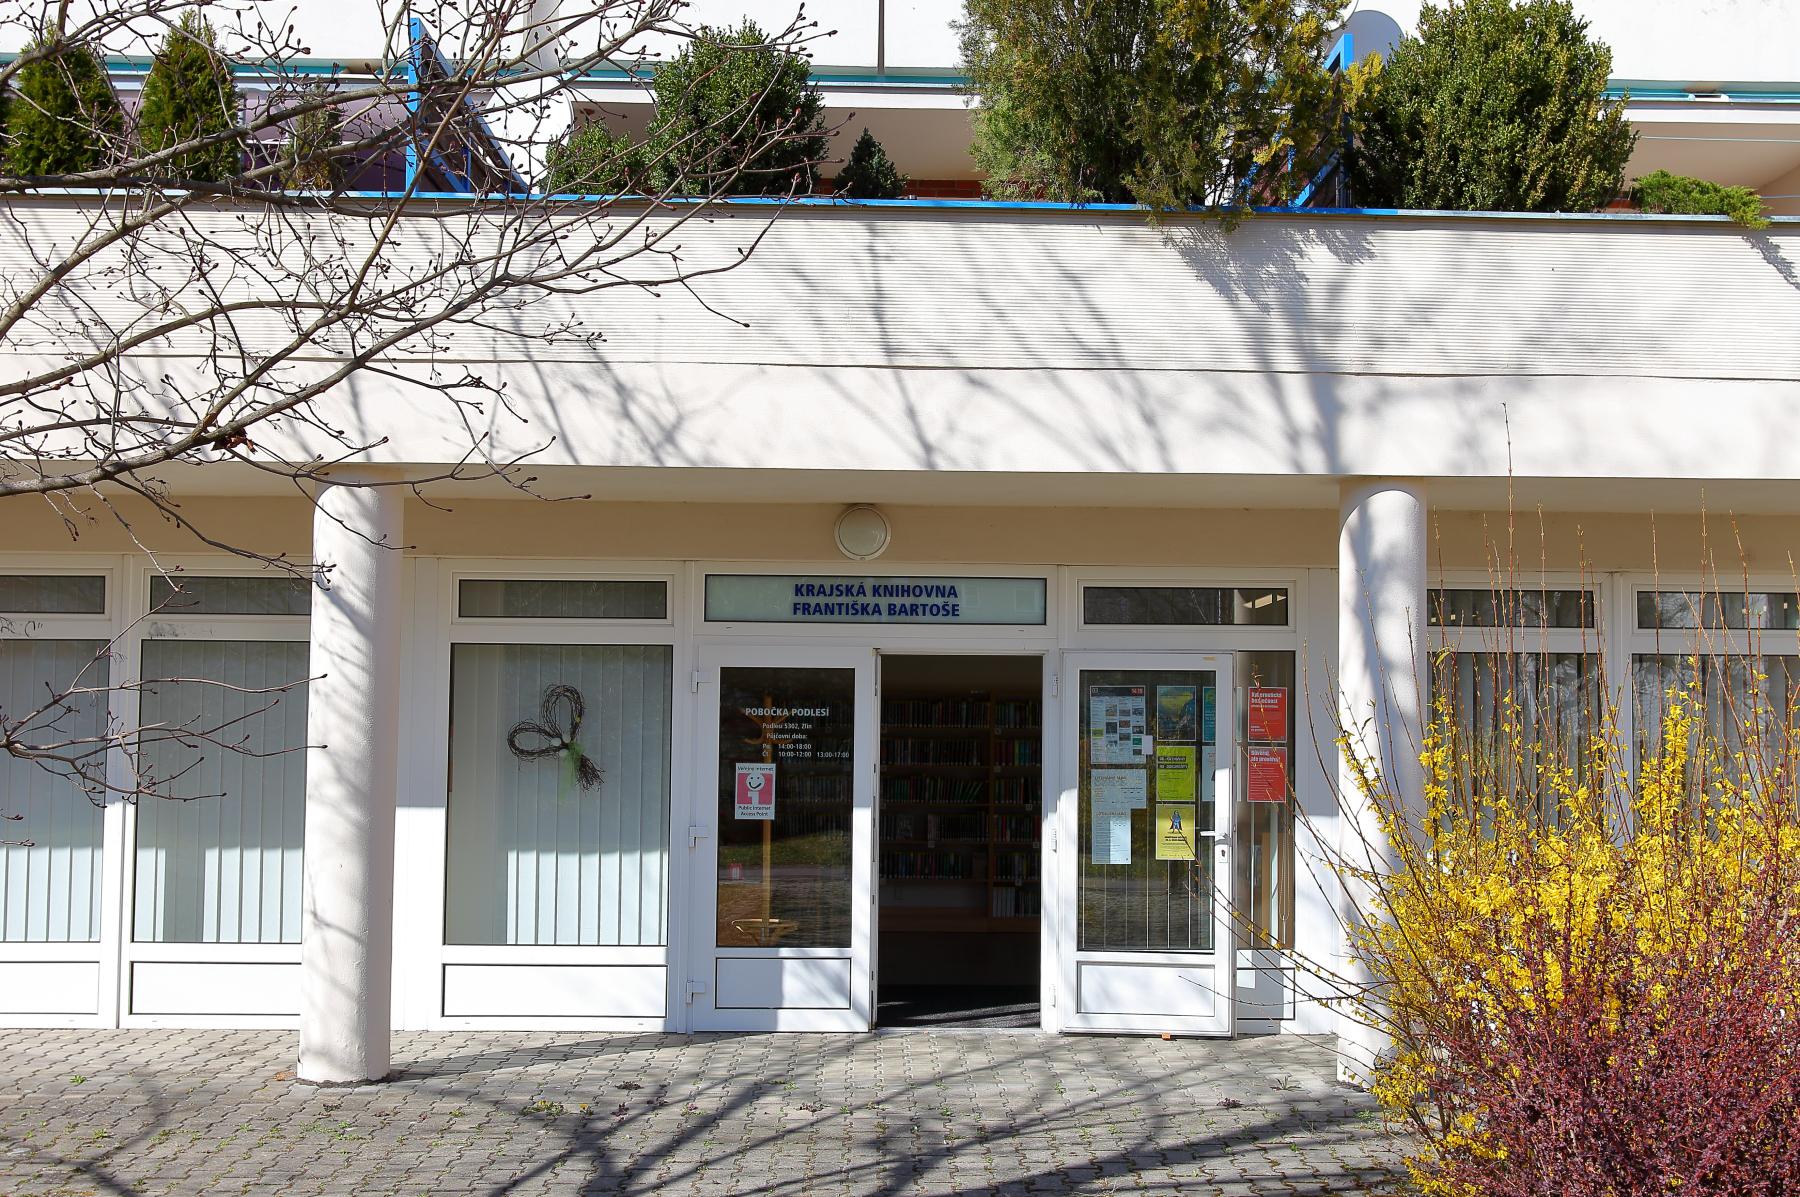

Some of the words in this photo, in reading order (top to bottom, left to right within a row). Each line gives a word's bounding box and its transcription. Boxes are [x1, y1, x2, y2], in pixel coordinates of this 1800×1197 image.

[794, 582, 866, 598] KRAJSKÁ
[872, 584, 958, 599] KNIHOVNA
[793, 600, 882, 616] FRANTIŠKA
[887, 601, 960, 617] BARTOŠE
[745, 706, 789, 717] POBOČKA
[791, 706, 829, 717] PODLESÍ
